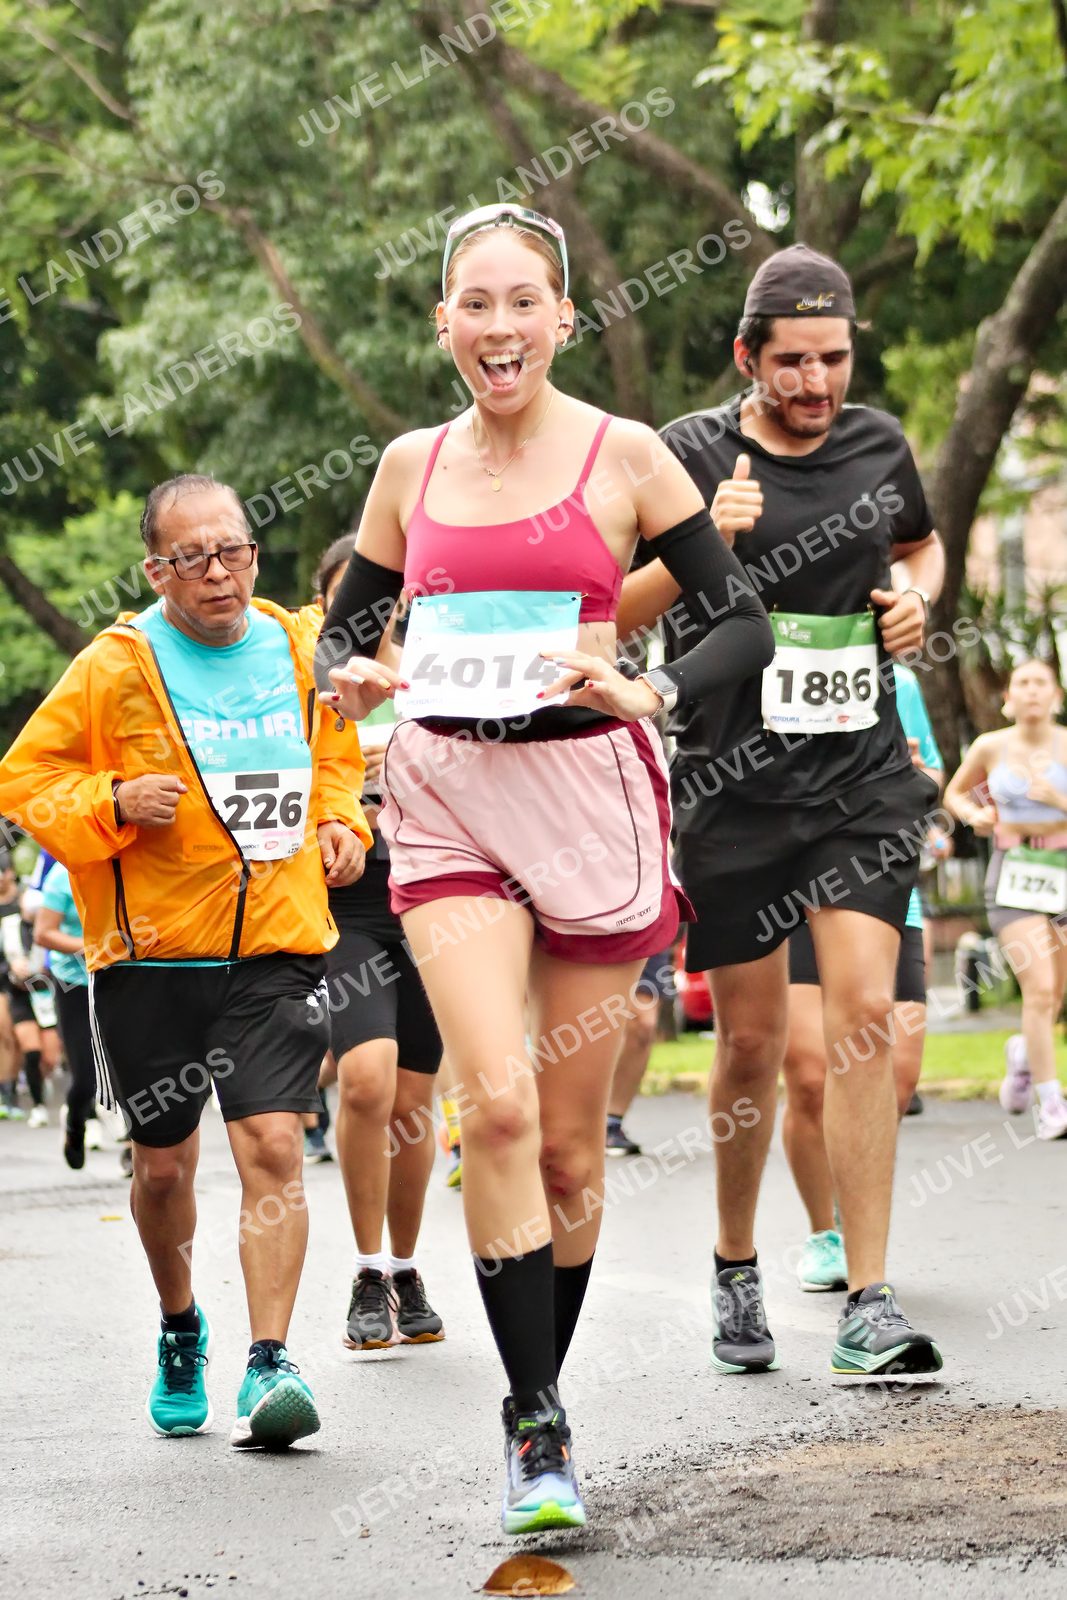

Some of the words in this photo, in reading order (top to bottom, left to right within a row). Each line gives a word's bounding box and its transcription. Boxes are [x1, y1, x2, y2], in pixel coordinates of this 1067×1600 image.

[412, 653, 560, 689] 4014
[776, 667, 871, 706] 1886
[181, 711, 305, 742] ERDUR
[211, 791, 303, 831] 226
